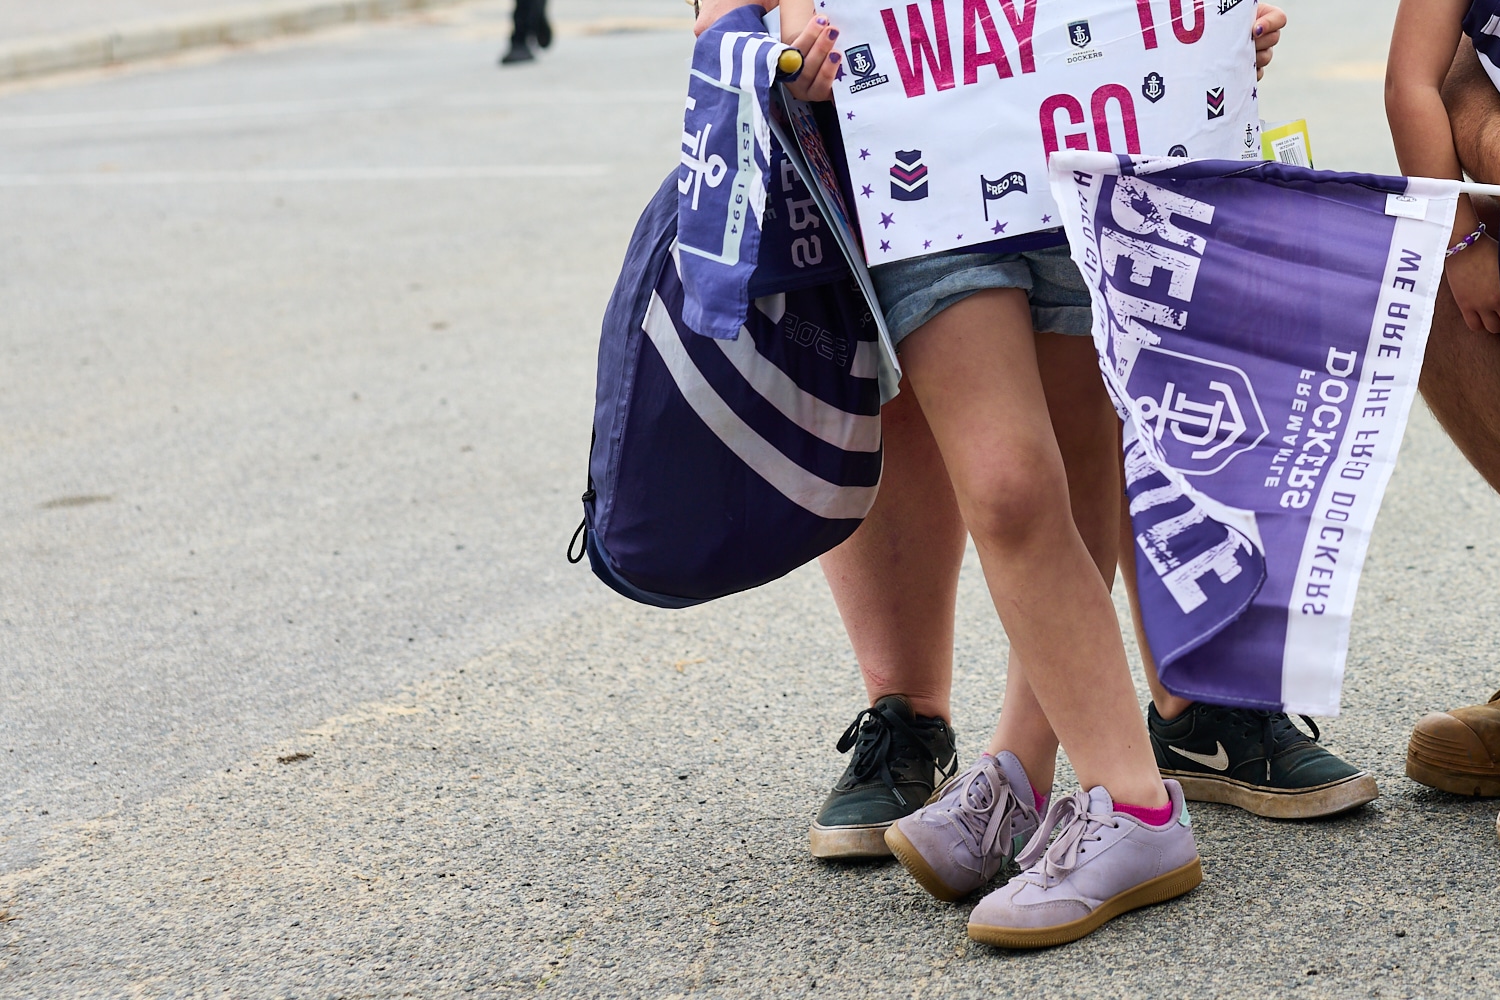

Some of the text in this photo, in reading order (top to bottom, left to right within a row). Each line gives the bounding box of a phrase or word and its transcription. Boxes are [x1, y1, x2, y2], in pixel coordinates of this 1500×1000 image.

[1066, 51, 1103, 64] DOCKERS
[850, 75, 888, 93] DOCKERS
[1038, 83, 1141, 168] GO
[730, 121, 751, 236] EST. 1994
[986, 178, 1010, 196] FREO
